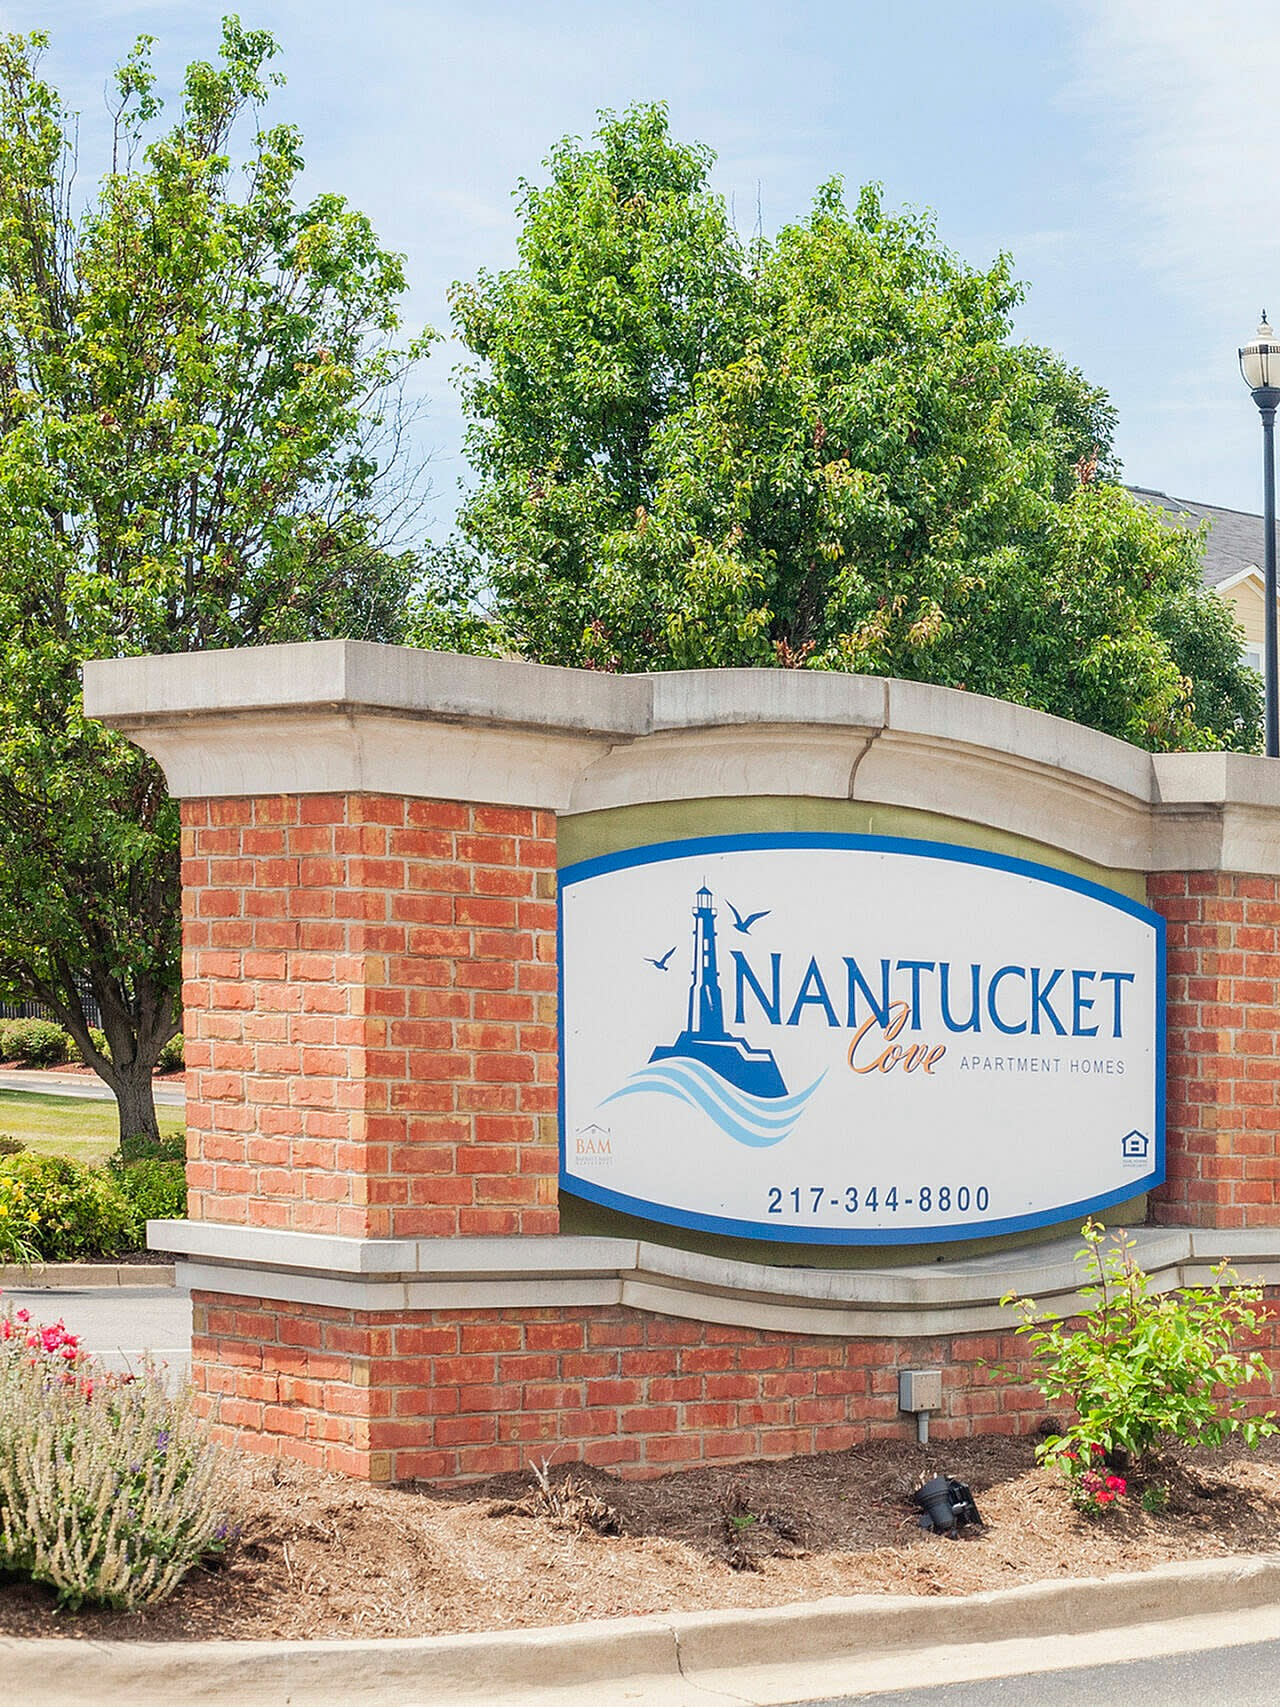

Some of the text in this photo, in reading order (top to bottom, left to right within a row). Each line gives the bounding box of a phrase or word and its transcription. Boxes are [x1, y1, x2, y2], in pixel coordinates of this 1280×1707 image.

[729, 950, 1136, 1038] NANTUCKET
[847, 999, 948, 1075] Cove
[960, 1056, 1126, 1075] APARTMENT HOMES
[575, 1138, 612, 1154] BAM
[767, 1186, 990, 1214] 217-344-8800
